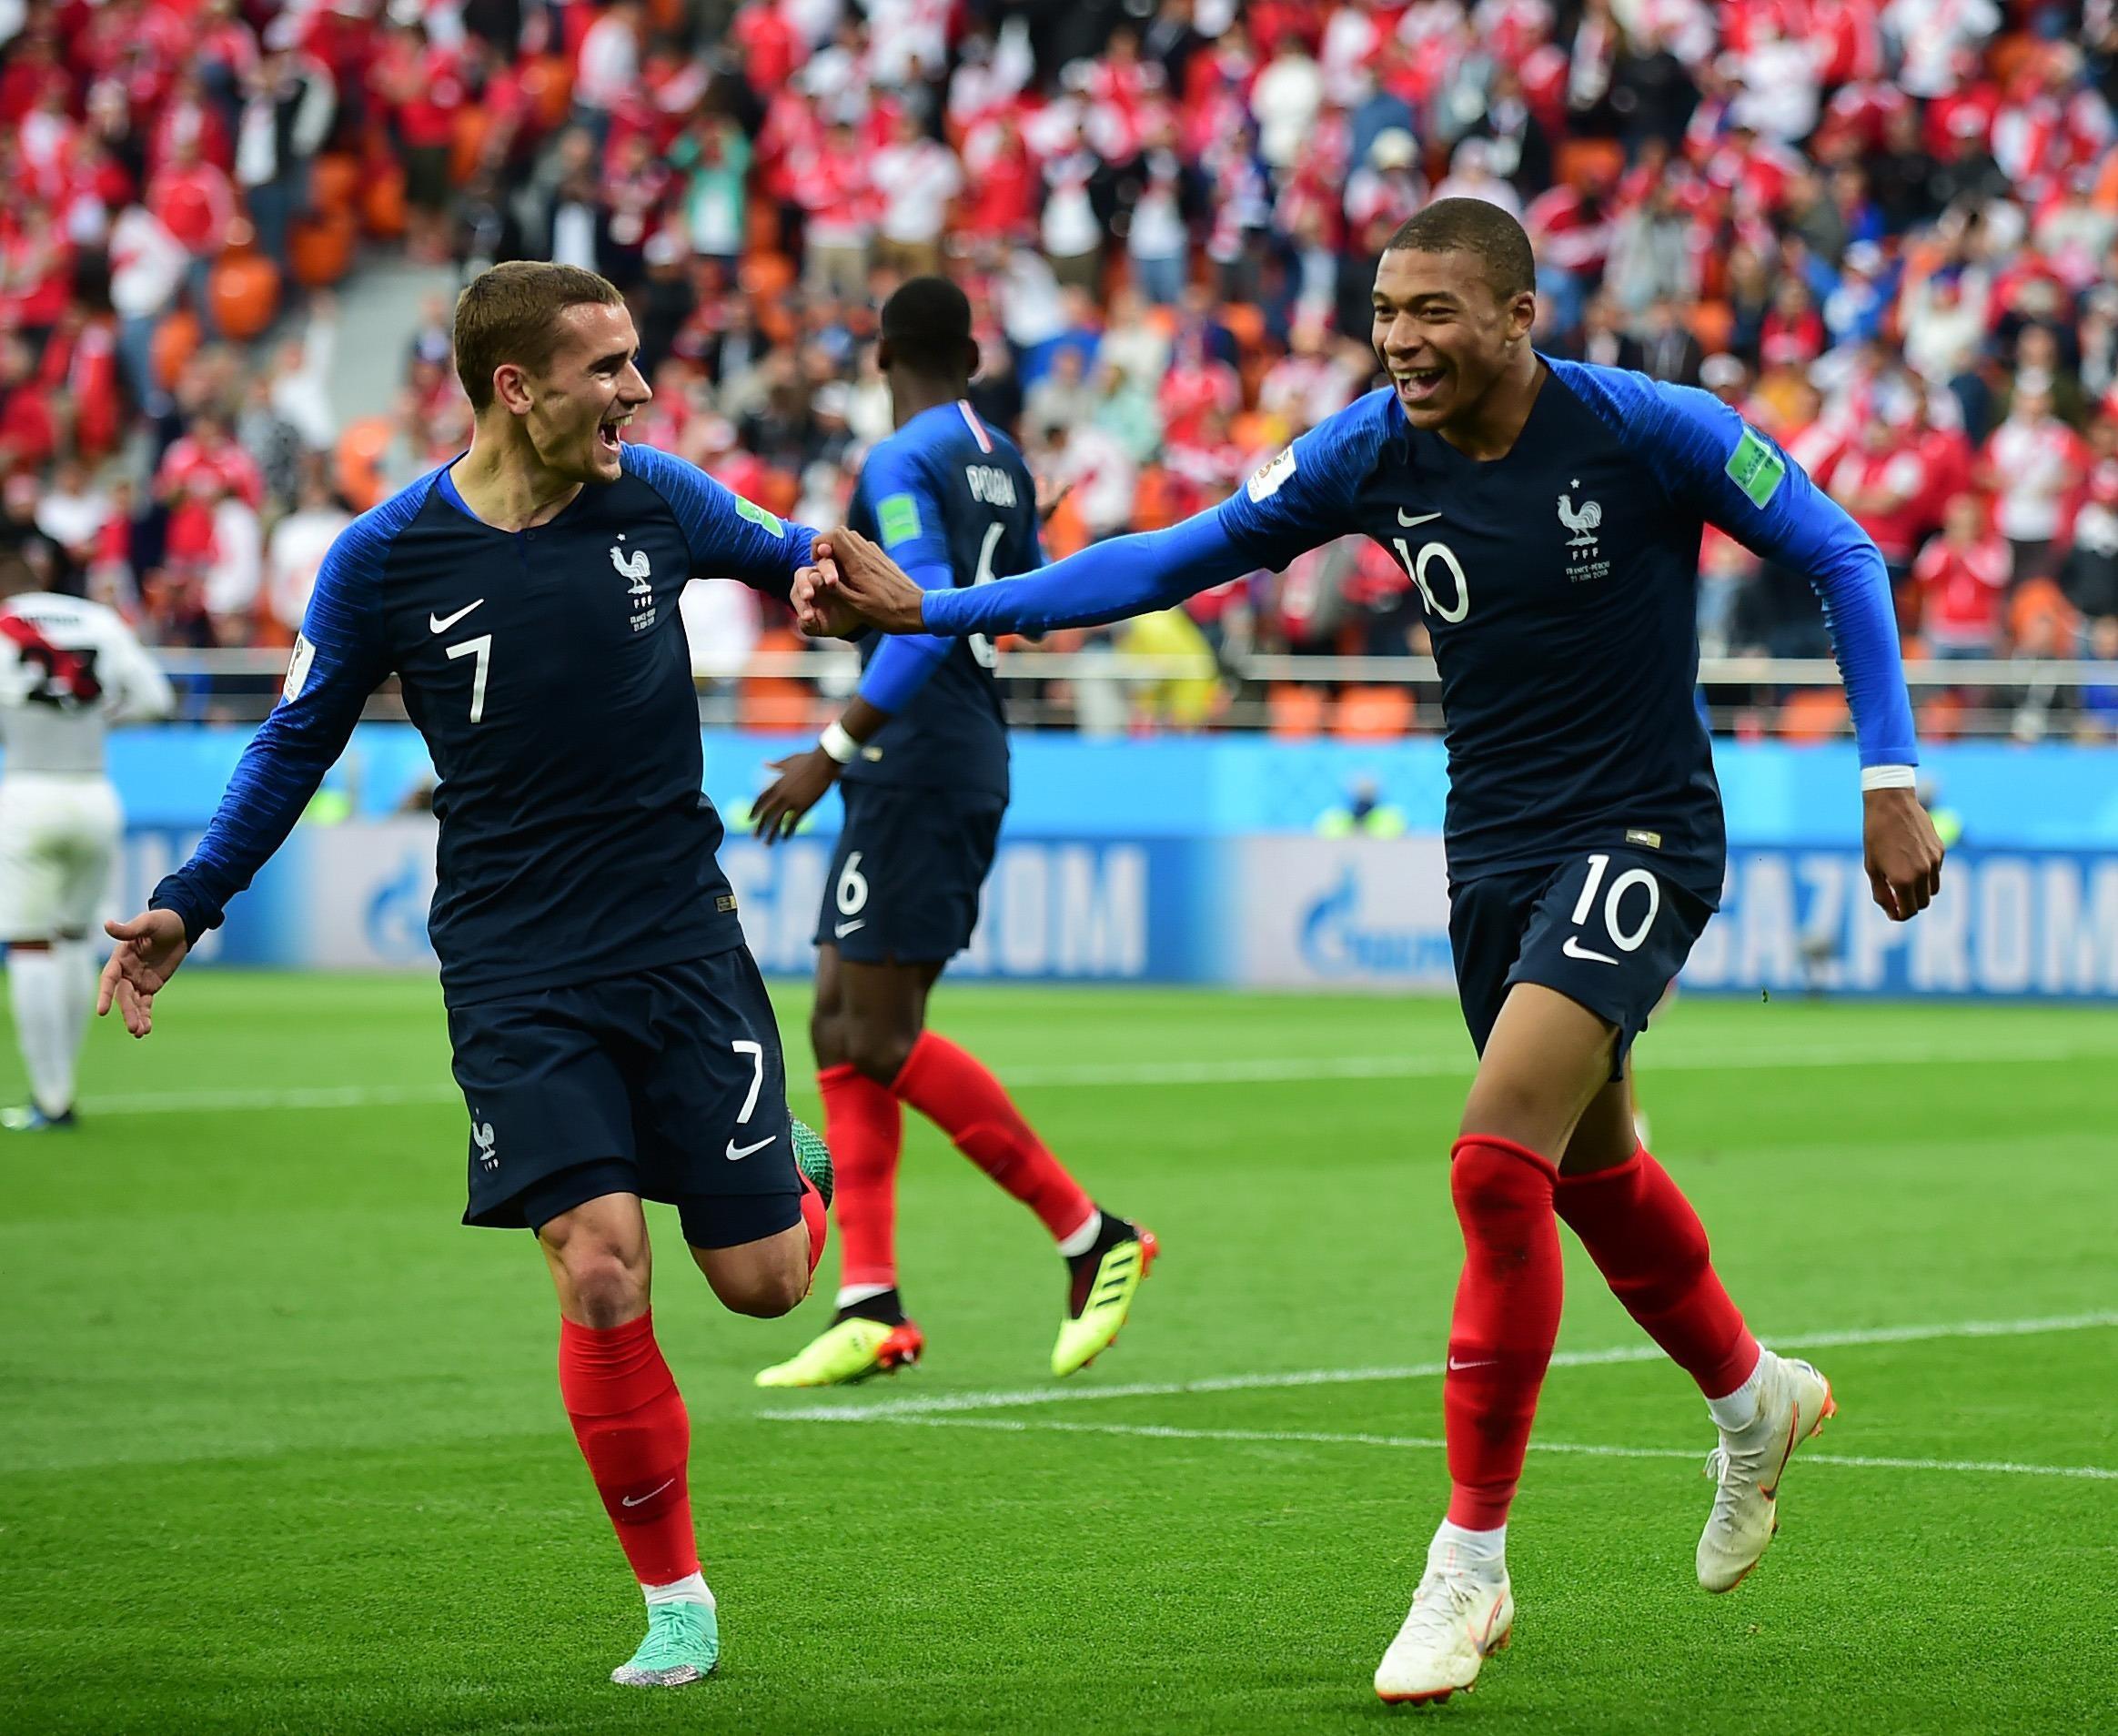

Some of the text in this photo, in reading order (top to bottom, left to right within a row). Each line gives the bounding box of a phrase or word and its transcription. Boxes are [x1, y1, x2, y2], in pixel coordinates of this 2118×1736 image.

[1393, 538, 1469, 623] 10
[1572, 547, 1599, 560] FFF
[446, 634, 492, 723] 7
[724, 841, 1149, 975] GAOM
[836, 851, 869, 915] 6
[1571, 854, 1659, 952] 10
[731, 1040, 763, 1124] 7
